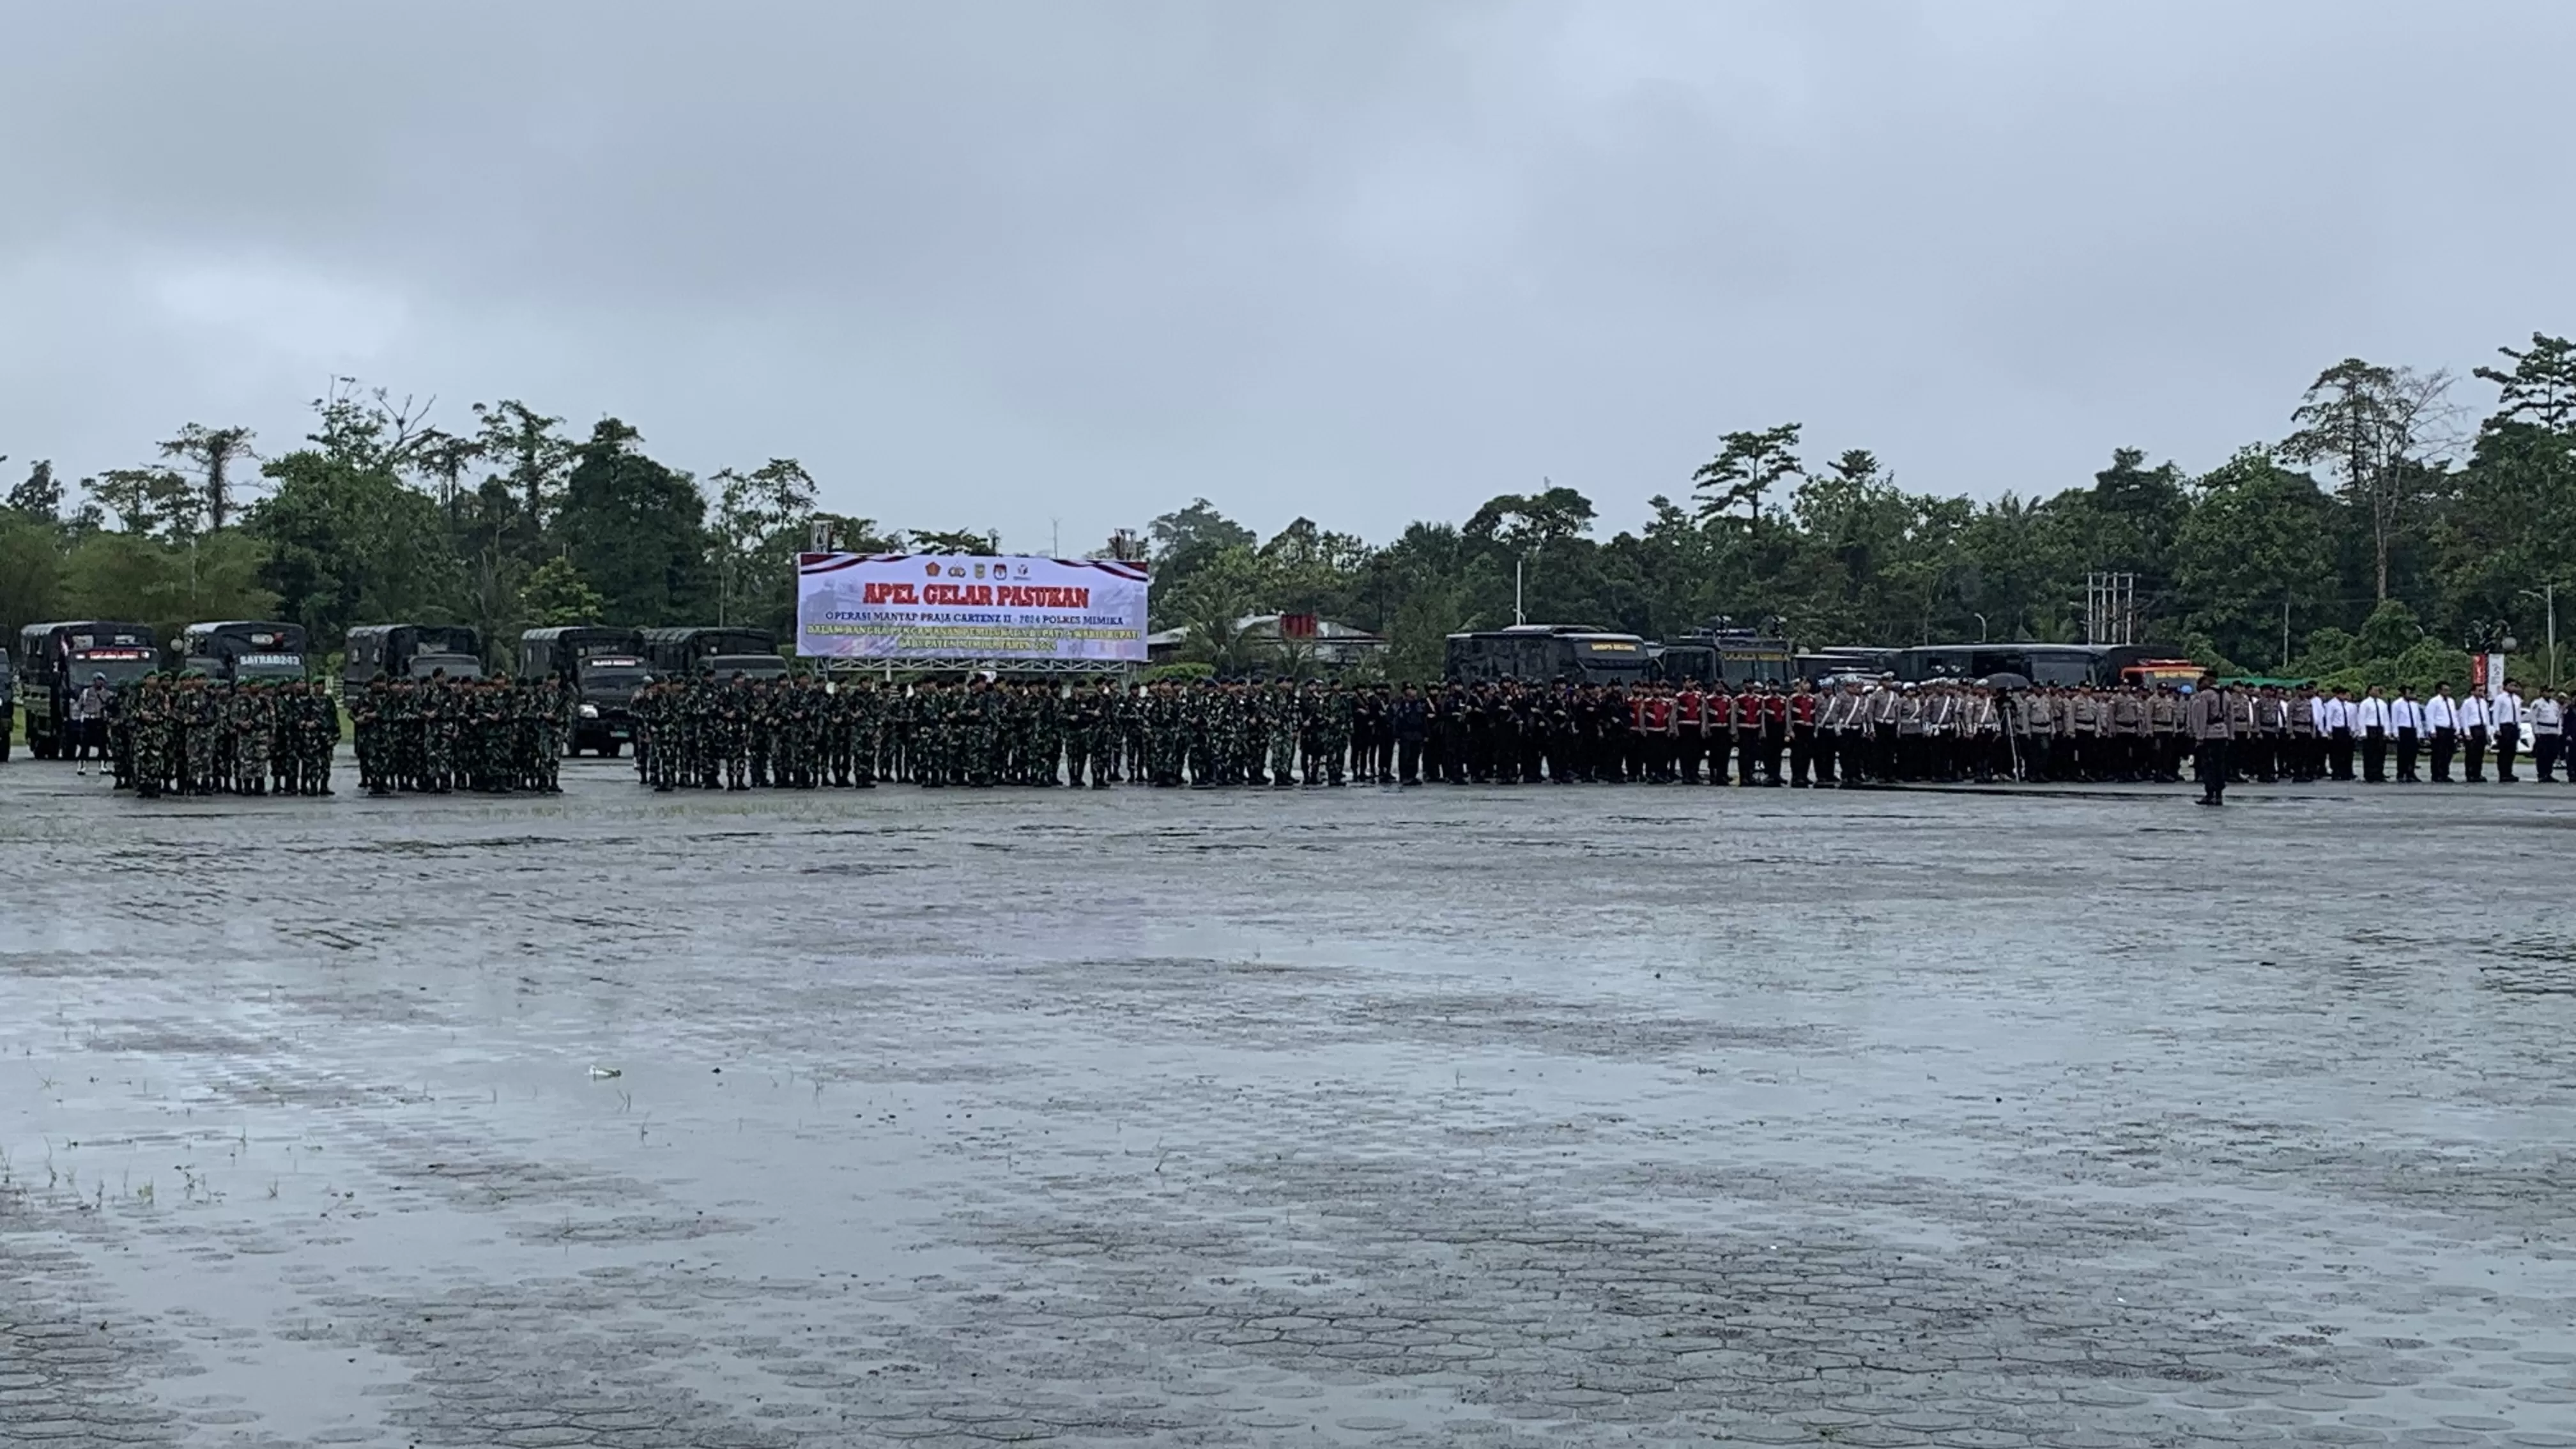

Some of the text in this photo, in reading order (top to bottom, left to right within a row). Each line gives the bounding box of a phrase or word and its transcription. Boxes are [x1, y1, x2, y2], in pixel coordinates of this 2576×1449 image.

[863, 583, 1089, 608] APEL GELAR PASUKAN
[825, 611, 870, 621] OPERASI
[873, 611, 917, 622] MANTAP
[920, 612, 951, 624] PRAJA
[953, 613, 1000, 623] CARTENZ
[1003, 614, 1011, 623] II
[1019, 615, 1040, 624] 2024
[1043, 615, 1080, 625] POLRES
[1083, 615, 1124, 625] MIMIKA
